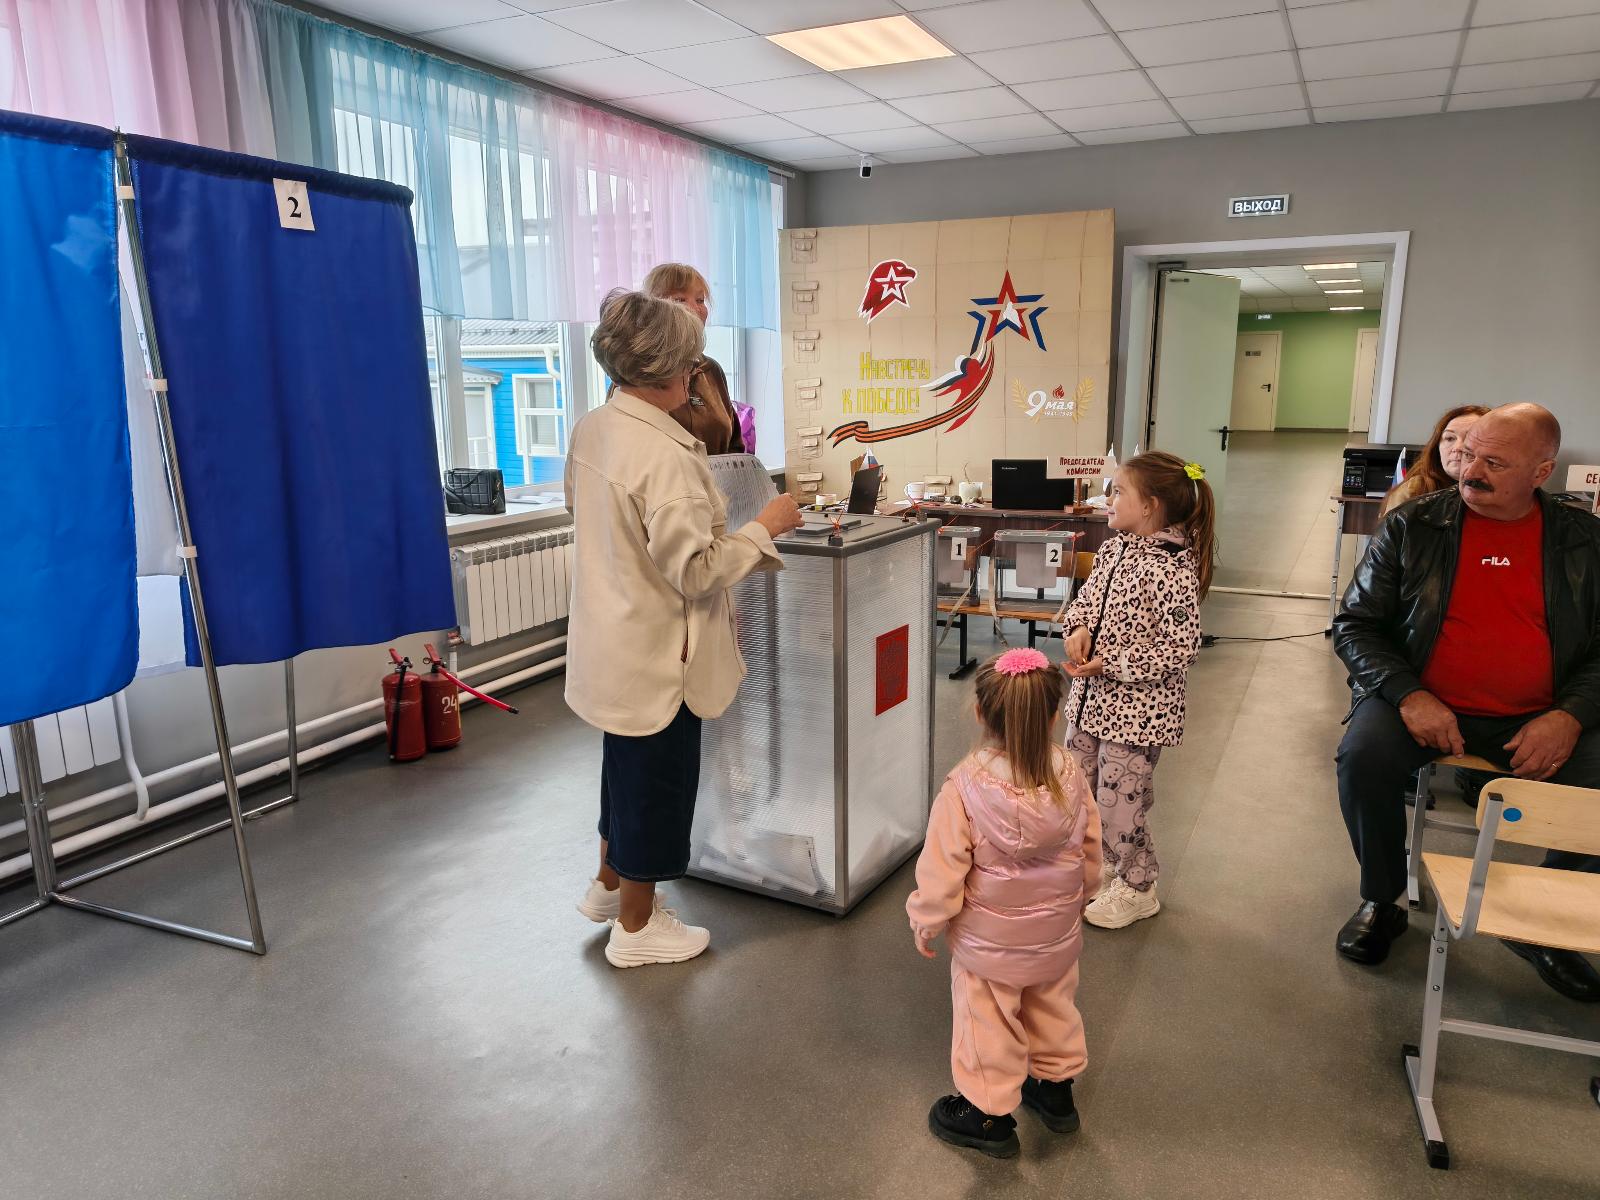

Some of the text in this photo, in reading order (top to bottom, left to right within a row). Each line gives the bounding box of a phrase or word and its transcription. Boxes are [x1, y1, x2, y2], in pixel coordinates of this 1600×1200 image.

[287, 196, 302, 219] 2
[1234, 199, 1282, 213] ВЫХОД
[1025, 390, 1076, 417] 9 мая
[1585, 473, 1600, 485] СЕ
[956, 542, 963, 557] 1
[1049, 548, 1059, 563] 2
[1481, 555, 1511, 566] FILA
[441, 694, 458, 714] 24
